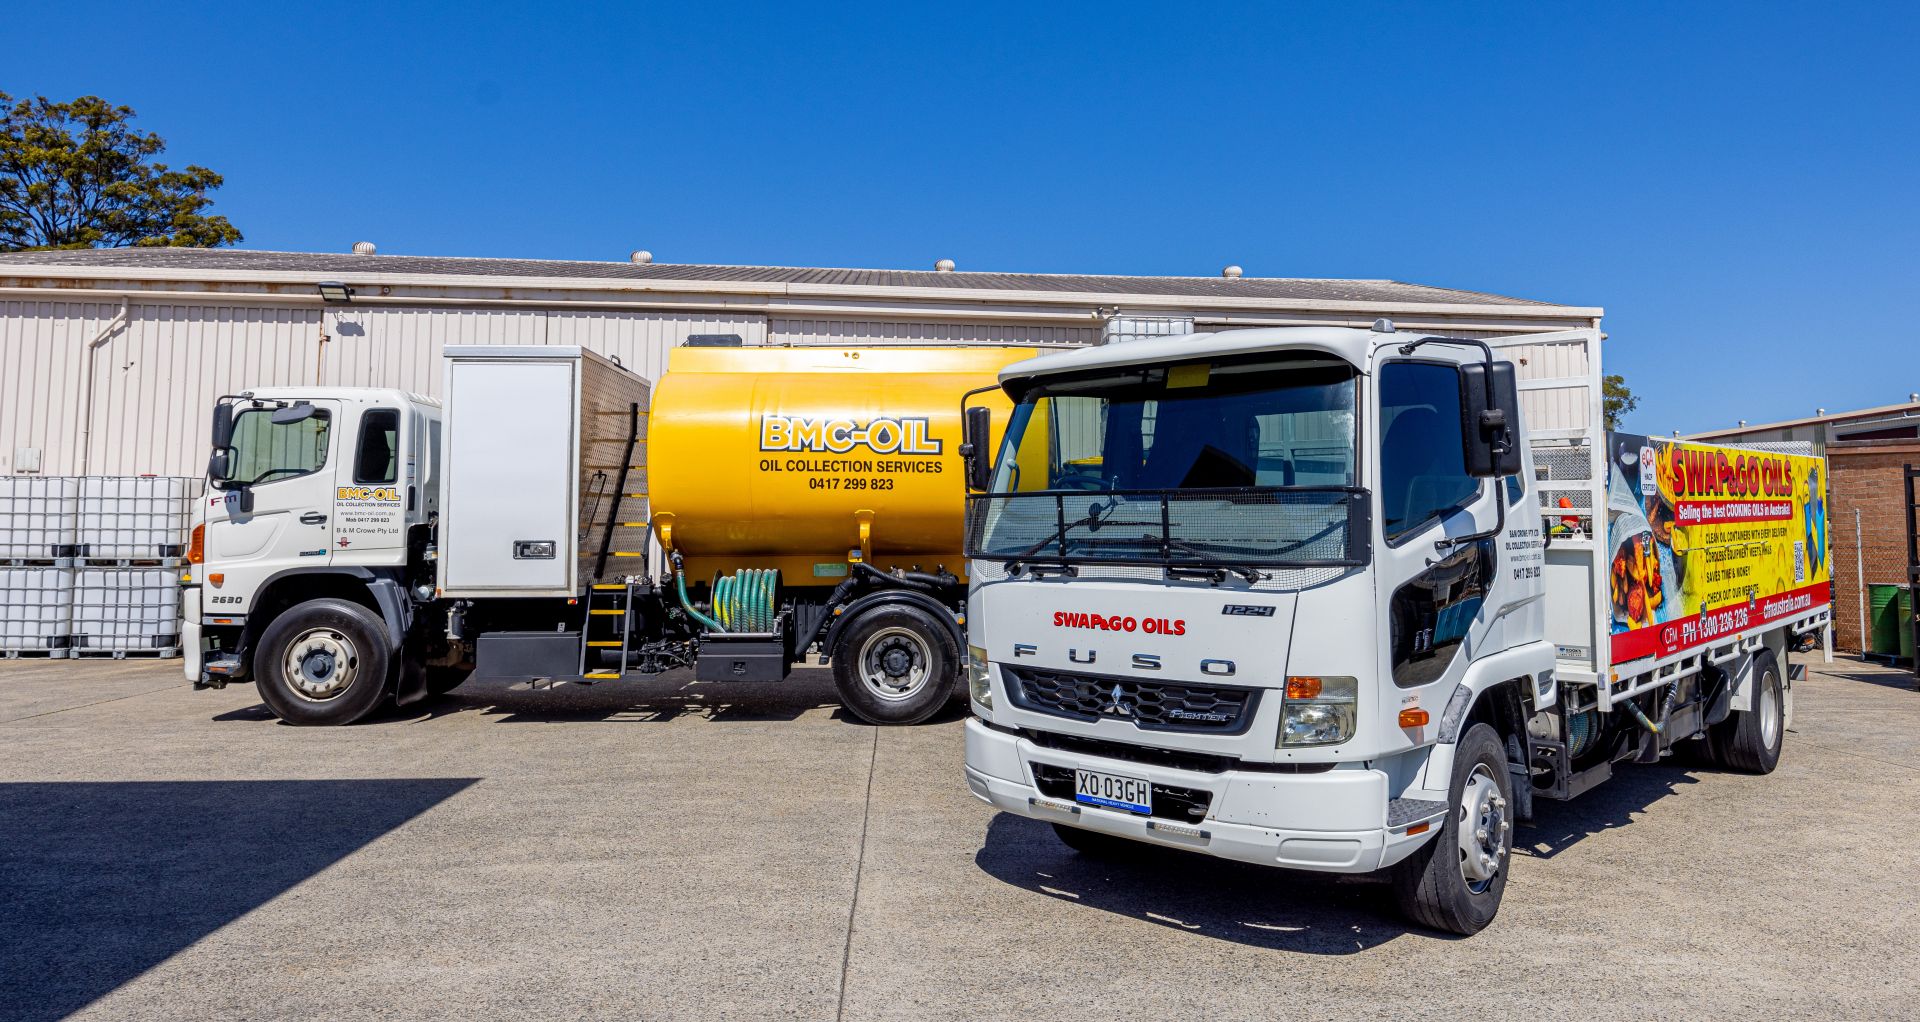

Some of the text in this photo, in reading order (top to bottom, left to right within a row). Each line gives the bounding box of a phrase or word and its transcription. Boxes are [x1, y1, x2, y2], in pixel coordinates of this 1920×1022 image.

[760, 415, 943, 455] BMC-OIL
[760, 460, 942, 473] OIL COLLECTION SERVICES
[1672, 449, 1792, 497] SWAP&GO OILS
[809, 478, 894, 490] 0417 299 823
[211, 495, 237, 506] FM
[337, 487, 401, 501] BMC-OIL
[1678, 504, 1700, 522] Selling
[1702, 504, 1712, 518] the
[1713, 504, 1726, 518] best
[1726, 503, 1752, 517] COOKING
[1752, 503, 1763, 516] OILS
[1764, 503, 1769, 516] in
[377, 527, 387, 535] Pty
[1705, 532, 1719, 544] CLEAN
[1727, 530, 1750, 542] CONTAINERS
[1707, 571, 1720, 583] SAVES
[1721, 568, 1731, 580] TIME
[1736, 565, 1750, 577] MONEY
[211, 596, 243, 604] 2630
[1707, 591, 1722, 604] CHECK
[1723, 589, 1731, 601] OUT
[1732, 586, 1741, 598] OUR
[1224, 604, 1273, 617] 1224
[1053, 611, 1186, 636] SWAP&GO OILS
[1683, 607, 1748, 644] PH 1300 236 236
[1664, 627, 1678, 644] CFM
[1014, 643, 1236, 676] FUSO
